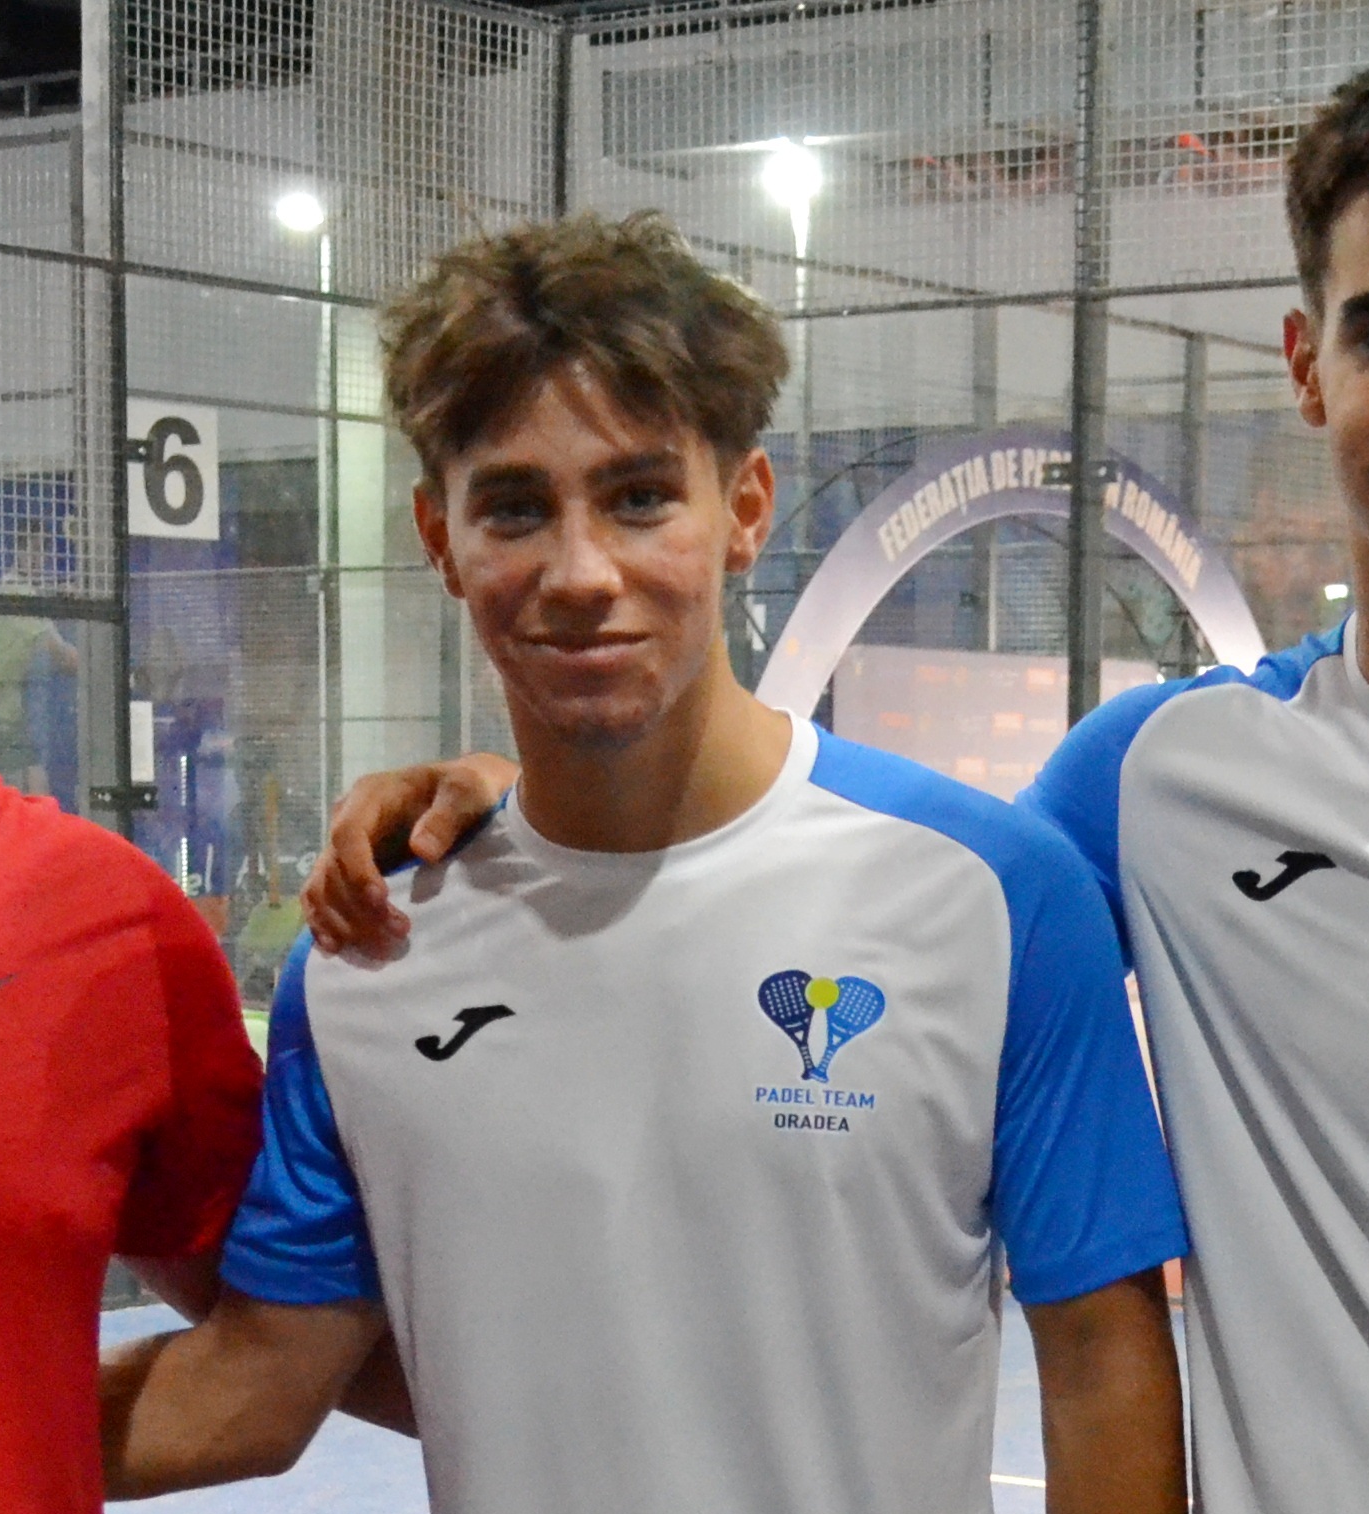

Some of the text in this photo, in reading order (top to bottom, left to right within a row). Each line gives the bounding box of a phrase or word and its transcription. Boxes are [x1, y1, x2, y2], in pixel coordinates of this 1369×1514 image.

[143, 416, 204, 526] 6
[990, 448, 1020, 492] DE
[755, 1086, 876, 1110] PADEL TEAM
[774, 1112, 850, 1133] ORADEA
